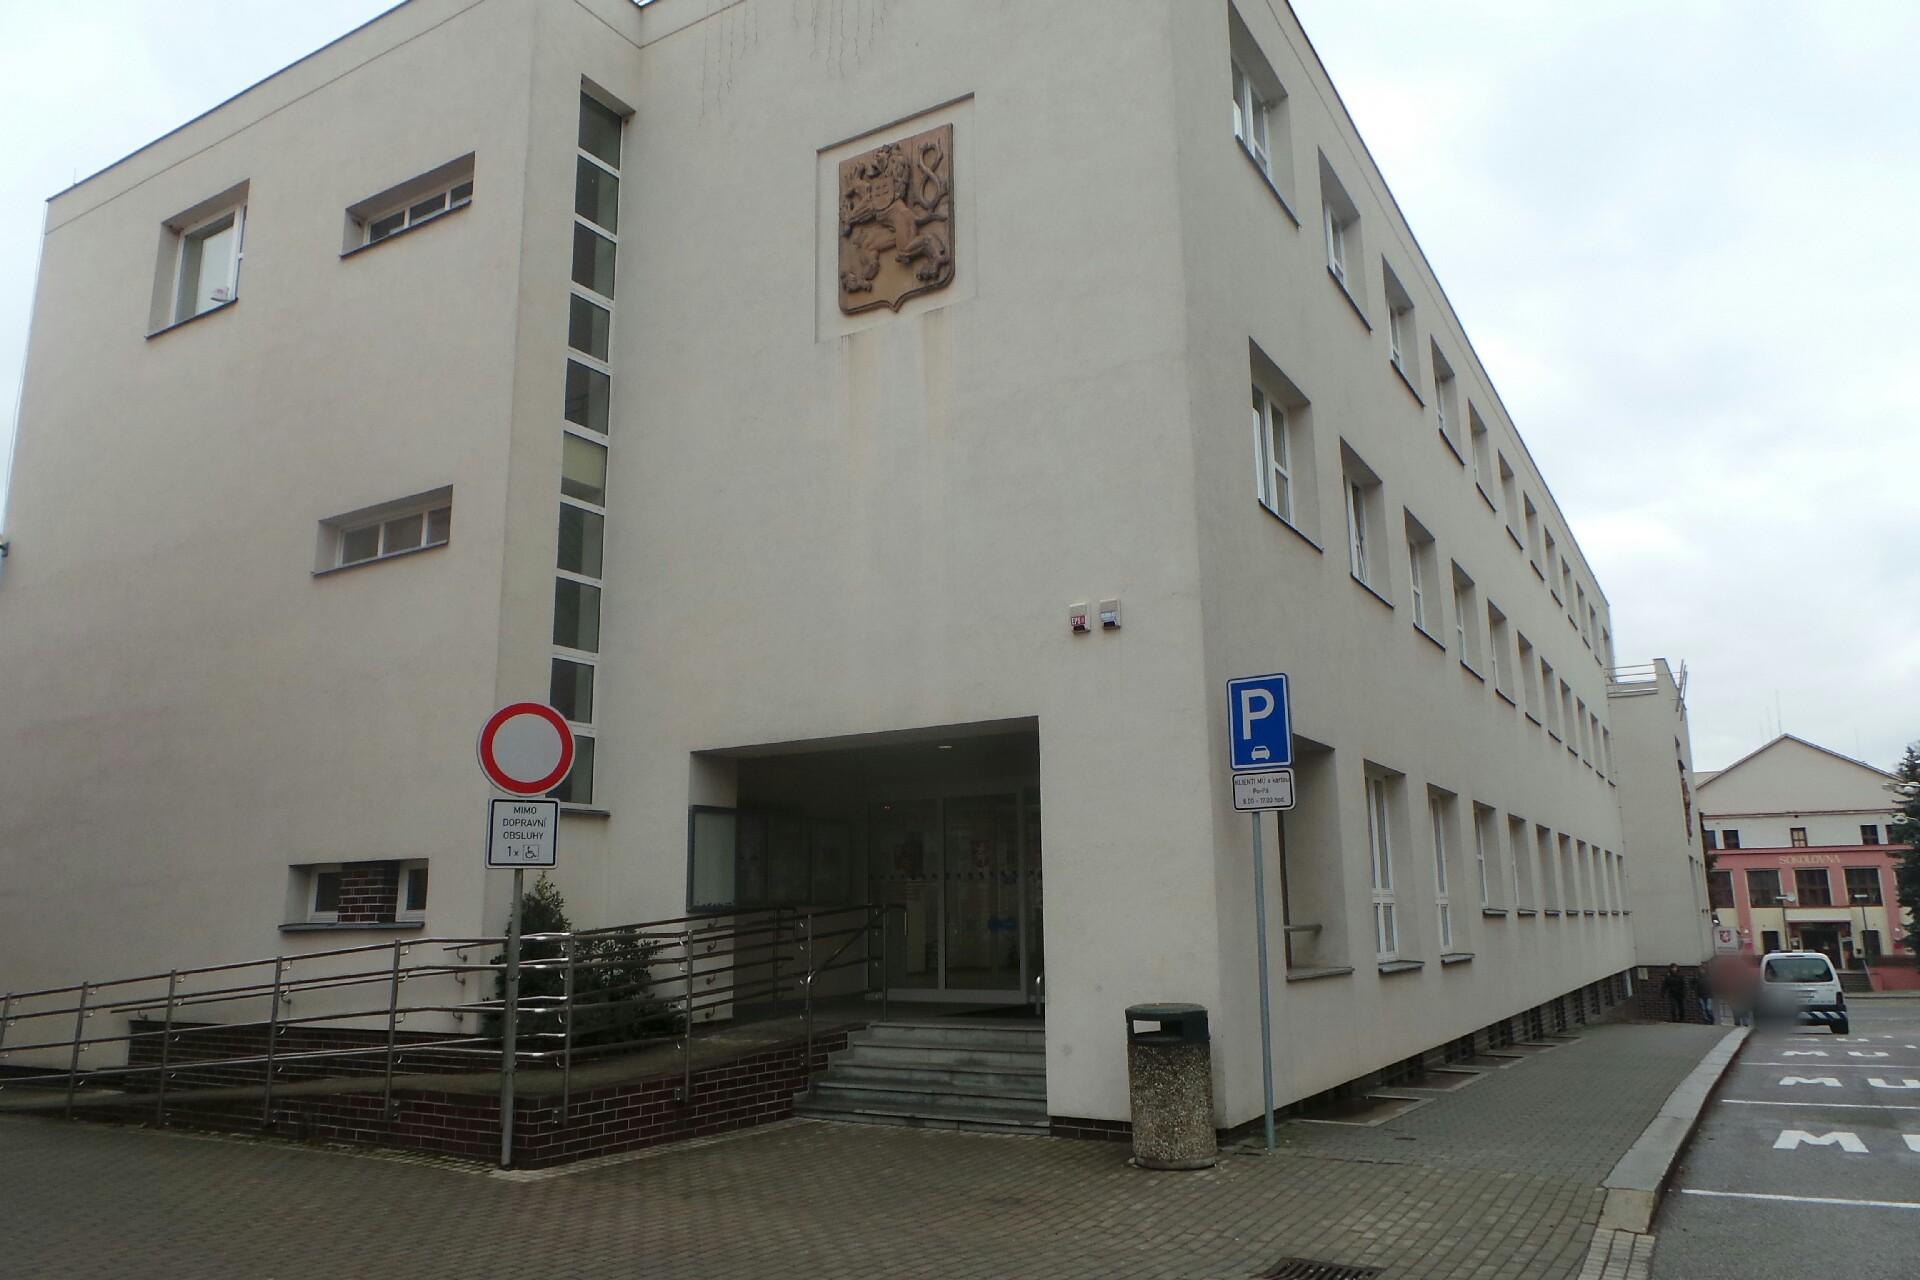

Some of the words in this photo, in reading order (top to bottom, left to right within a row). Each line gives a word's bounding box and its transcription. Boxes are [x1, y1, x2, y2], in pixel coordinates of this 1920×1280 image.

[1241, 688, 1275, 740] P
[513, 806, 537, 815] MIMO
[502, 818, 546, 828] DOPRAVNÍ
[503, 831, 544, 840] OBSLUHY
[1777, 854, 1841, 865] SOKOLOVNA
